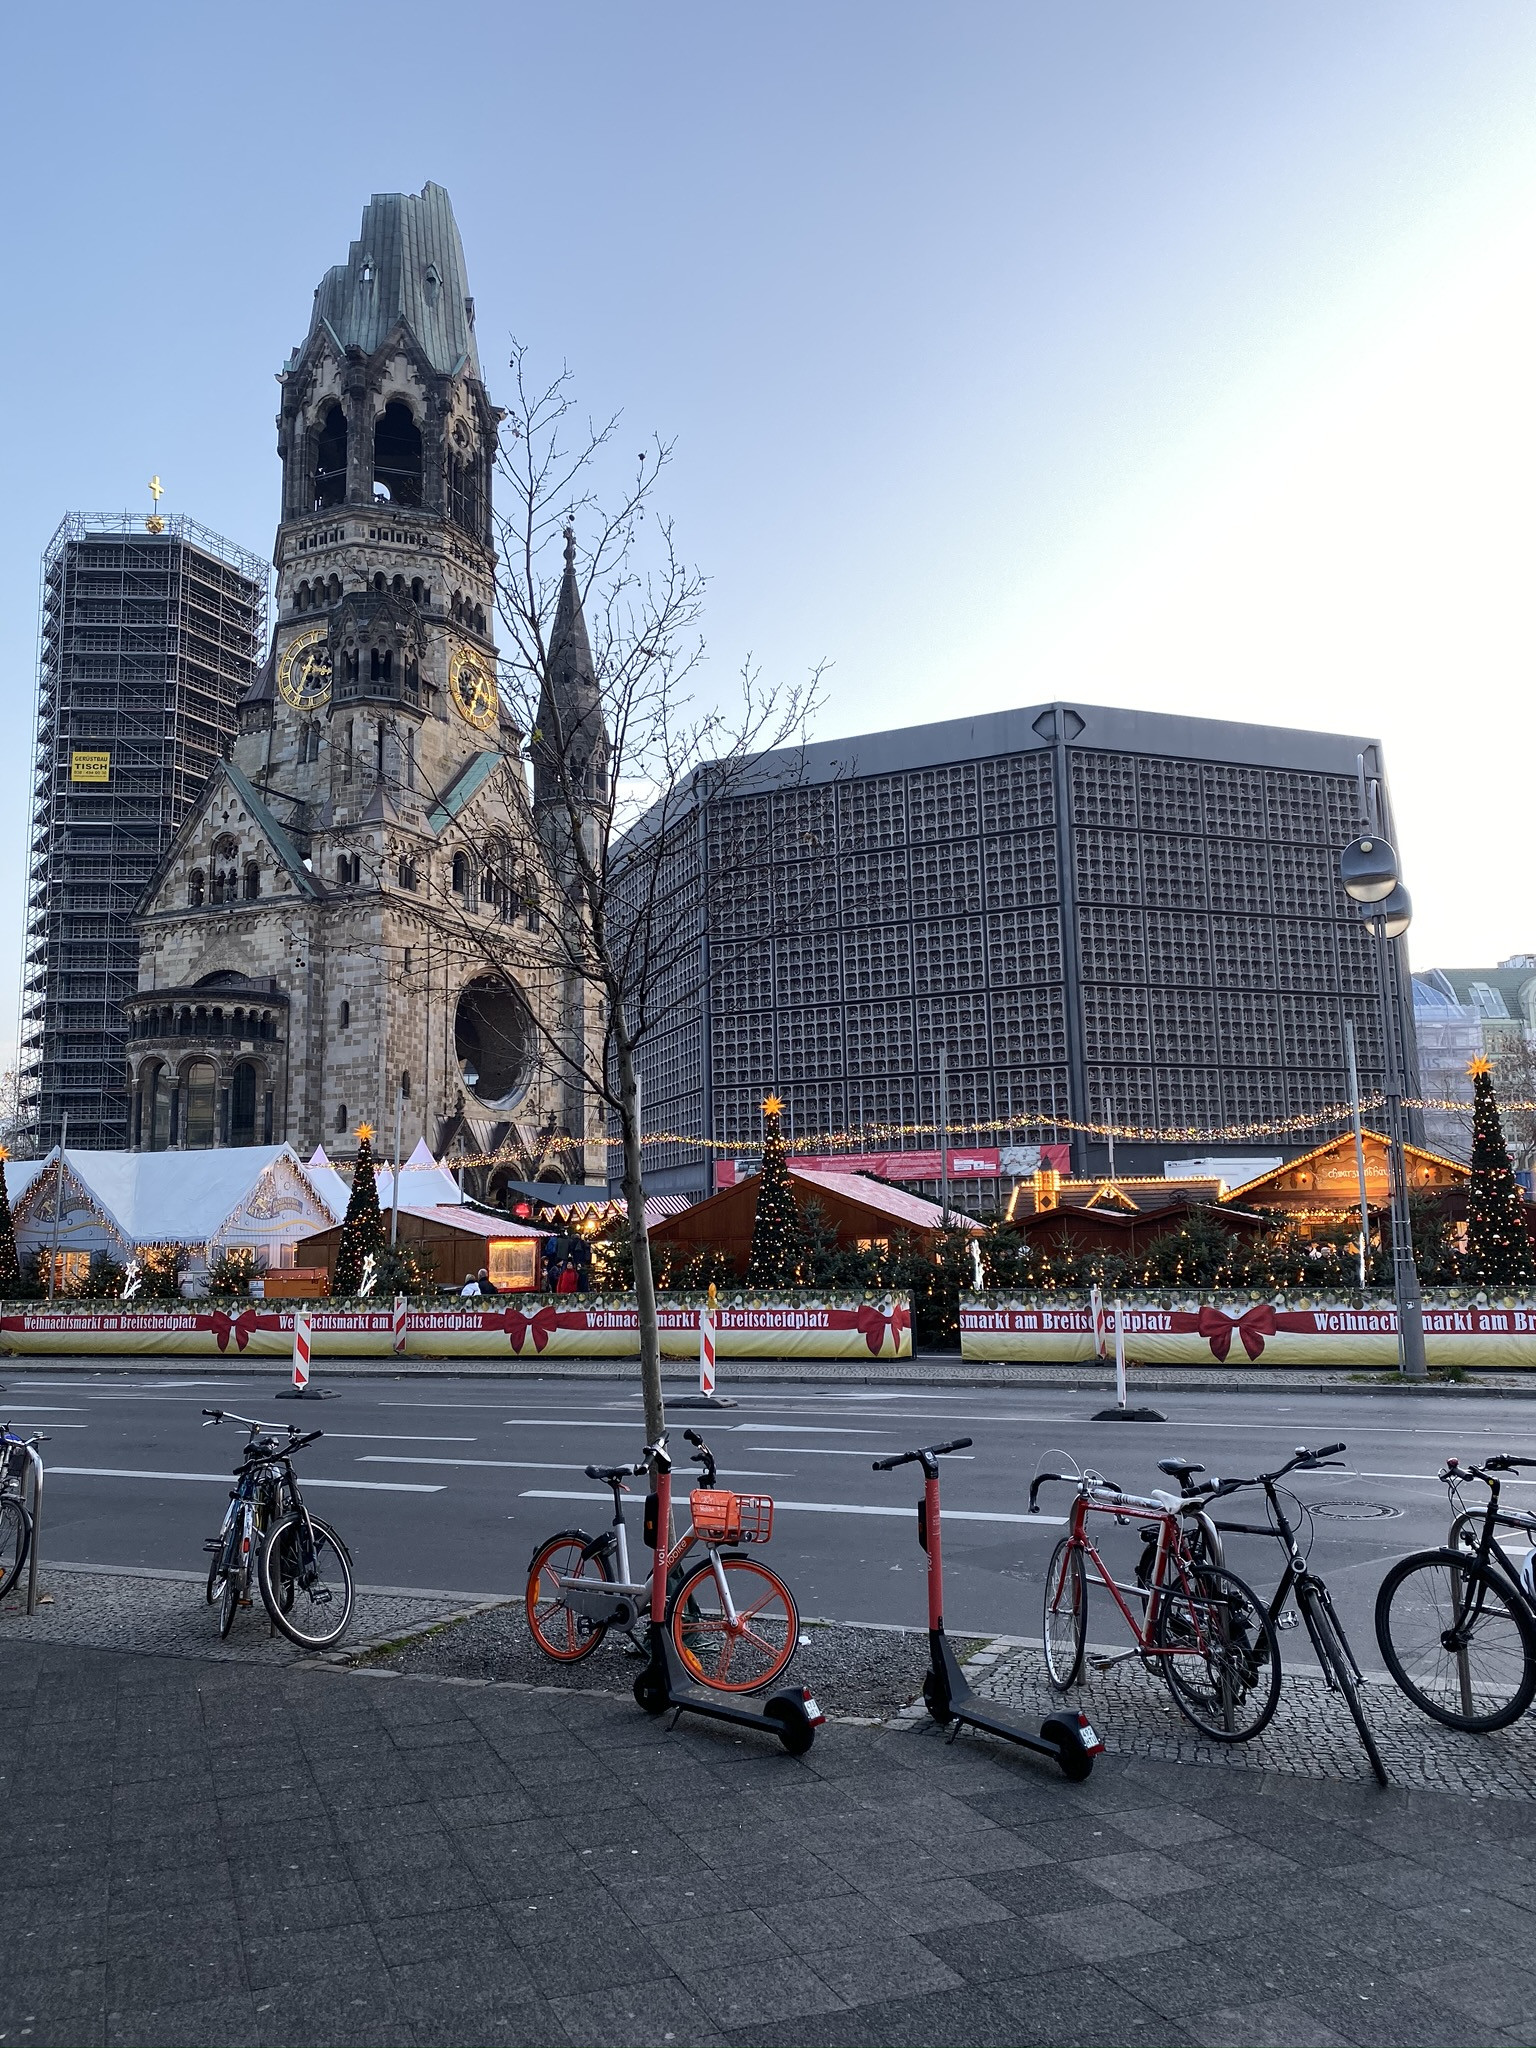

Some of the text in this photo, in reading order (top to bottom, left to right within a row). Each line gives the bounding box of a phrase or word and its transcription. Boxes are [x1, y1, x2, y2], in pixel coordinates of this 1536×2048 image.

[24, 1316, 197, 1331] Weihnachtsmarkt am Breitscheidplatz
[279, 1314, 483, 1331] Weachtsmarkt am eitscheidplatz
[586, 1312, 695, 1328] Weihnacmarkt
[721, 1312, 829, 1329] Breitscheidplatz
[1015, 1315, 1038, 1329] am
[1043, 1312, 1172, 1332] Breitscedplatz
[1313, 1312, 1473, 1331] Weihnachmarkt
[1479, 1315, 1508, 1331] am
